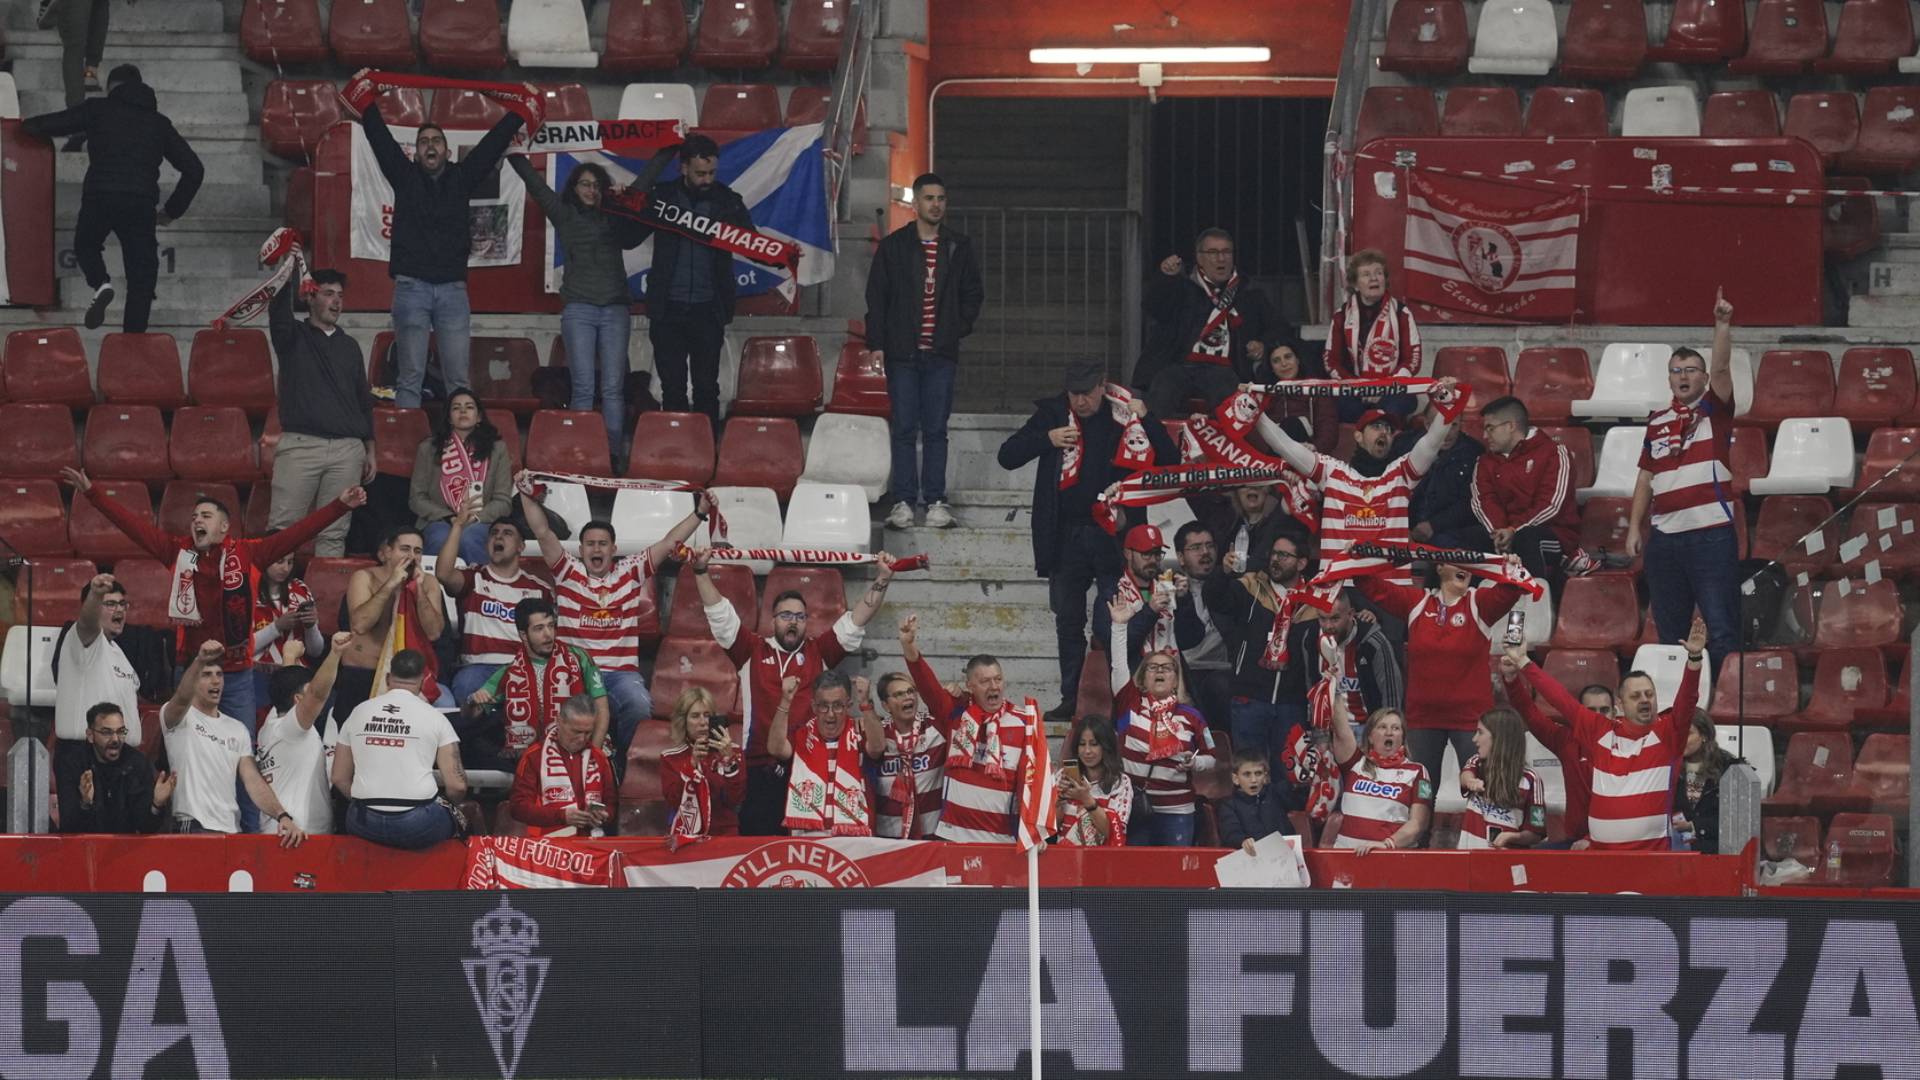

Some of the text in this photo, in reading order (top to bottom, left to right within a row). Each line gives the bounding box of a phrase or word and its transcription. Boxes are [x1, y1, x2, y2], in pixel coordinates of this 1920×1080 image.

[1142, 470, 1181, 487] Peña
[1187, 467, 1210, 484] del
[364, 723, 411, 735] AWAYDAYS
[881, 755, 930, 776] wier
[1353, 779, 1401, 798] wiber
[520, 838, 594, 875] FÚTBOL
[788, 844, 864, 888] NEVE
[0, 896, 231, 1080] GA
[841, 908, 1920, 1080] LA FUERZA
